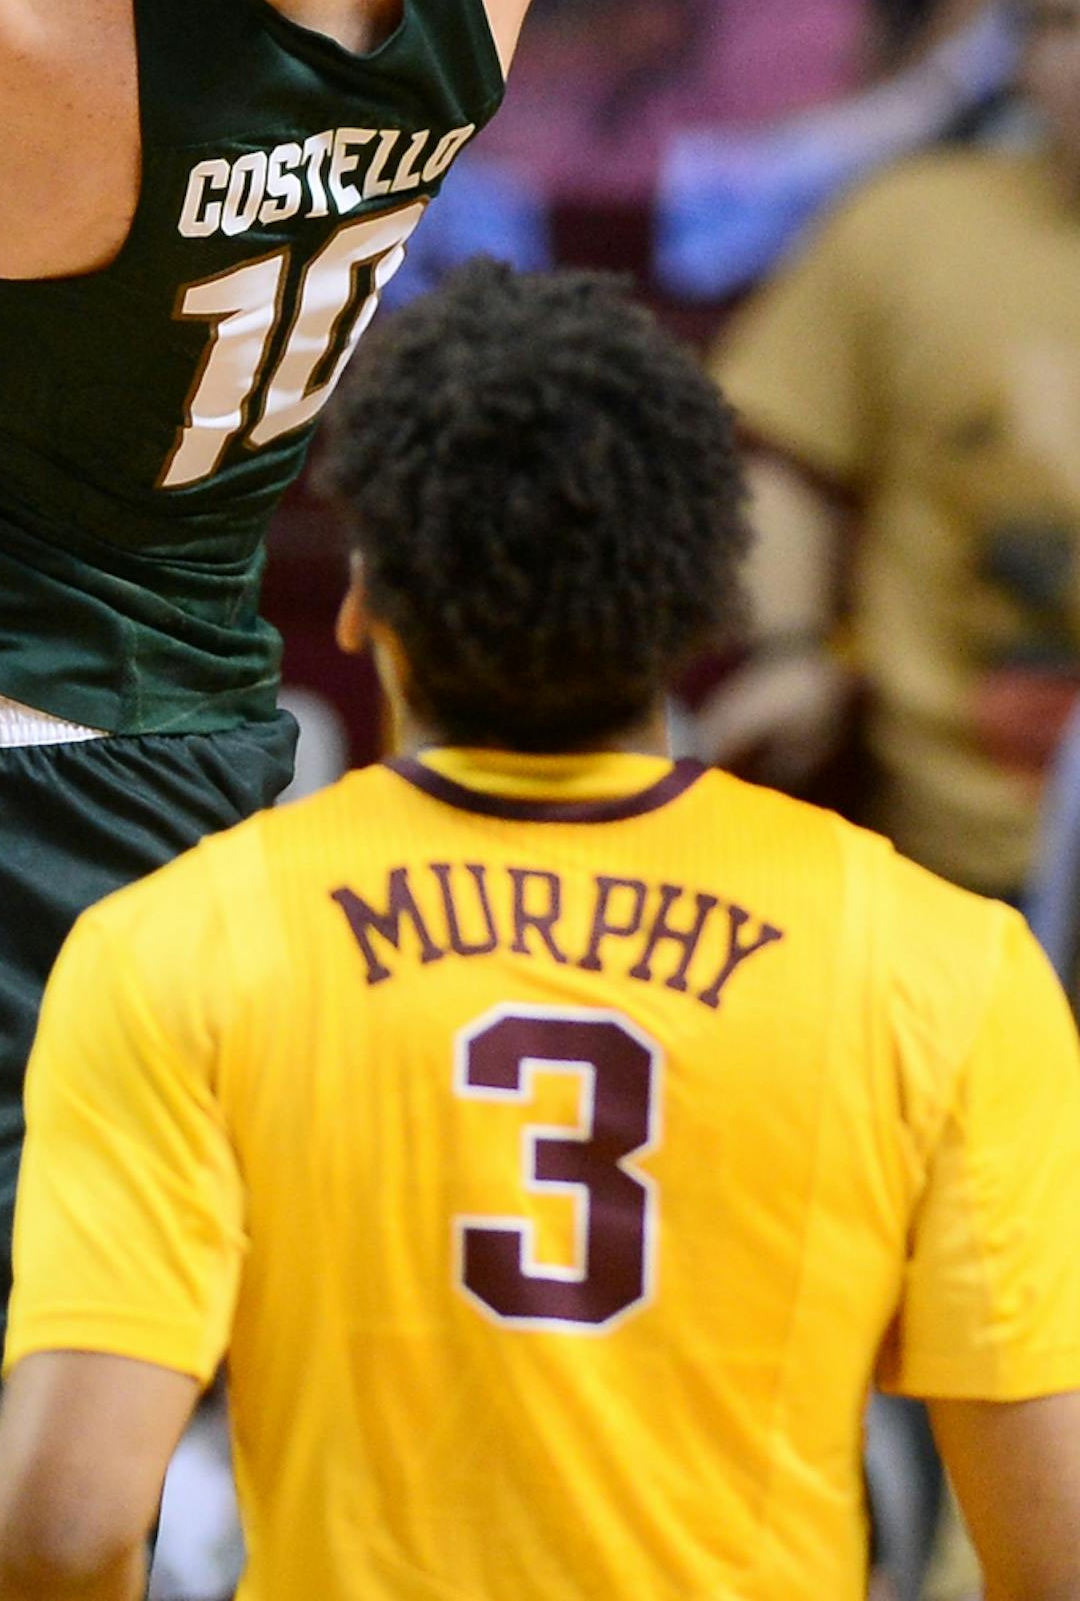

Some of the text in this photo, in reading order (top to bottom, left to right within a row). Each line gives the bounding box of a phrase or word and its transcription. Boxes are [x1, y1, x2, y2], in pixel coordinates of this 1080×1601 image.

[177, 122, 476, 238] COSTELLO
[155, 196, 430, 490] 10
[330, 862, 783, 1010] MURPHY
[453, 1000, 663, 1333] 3
